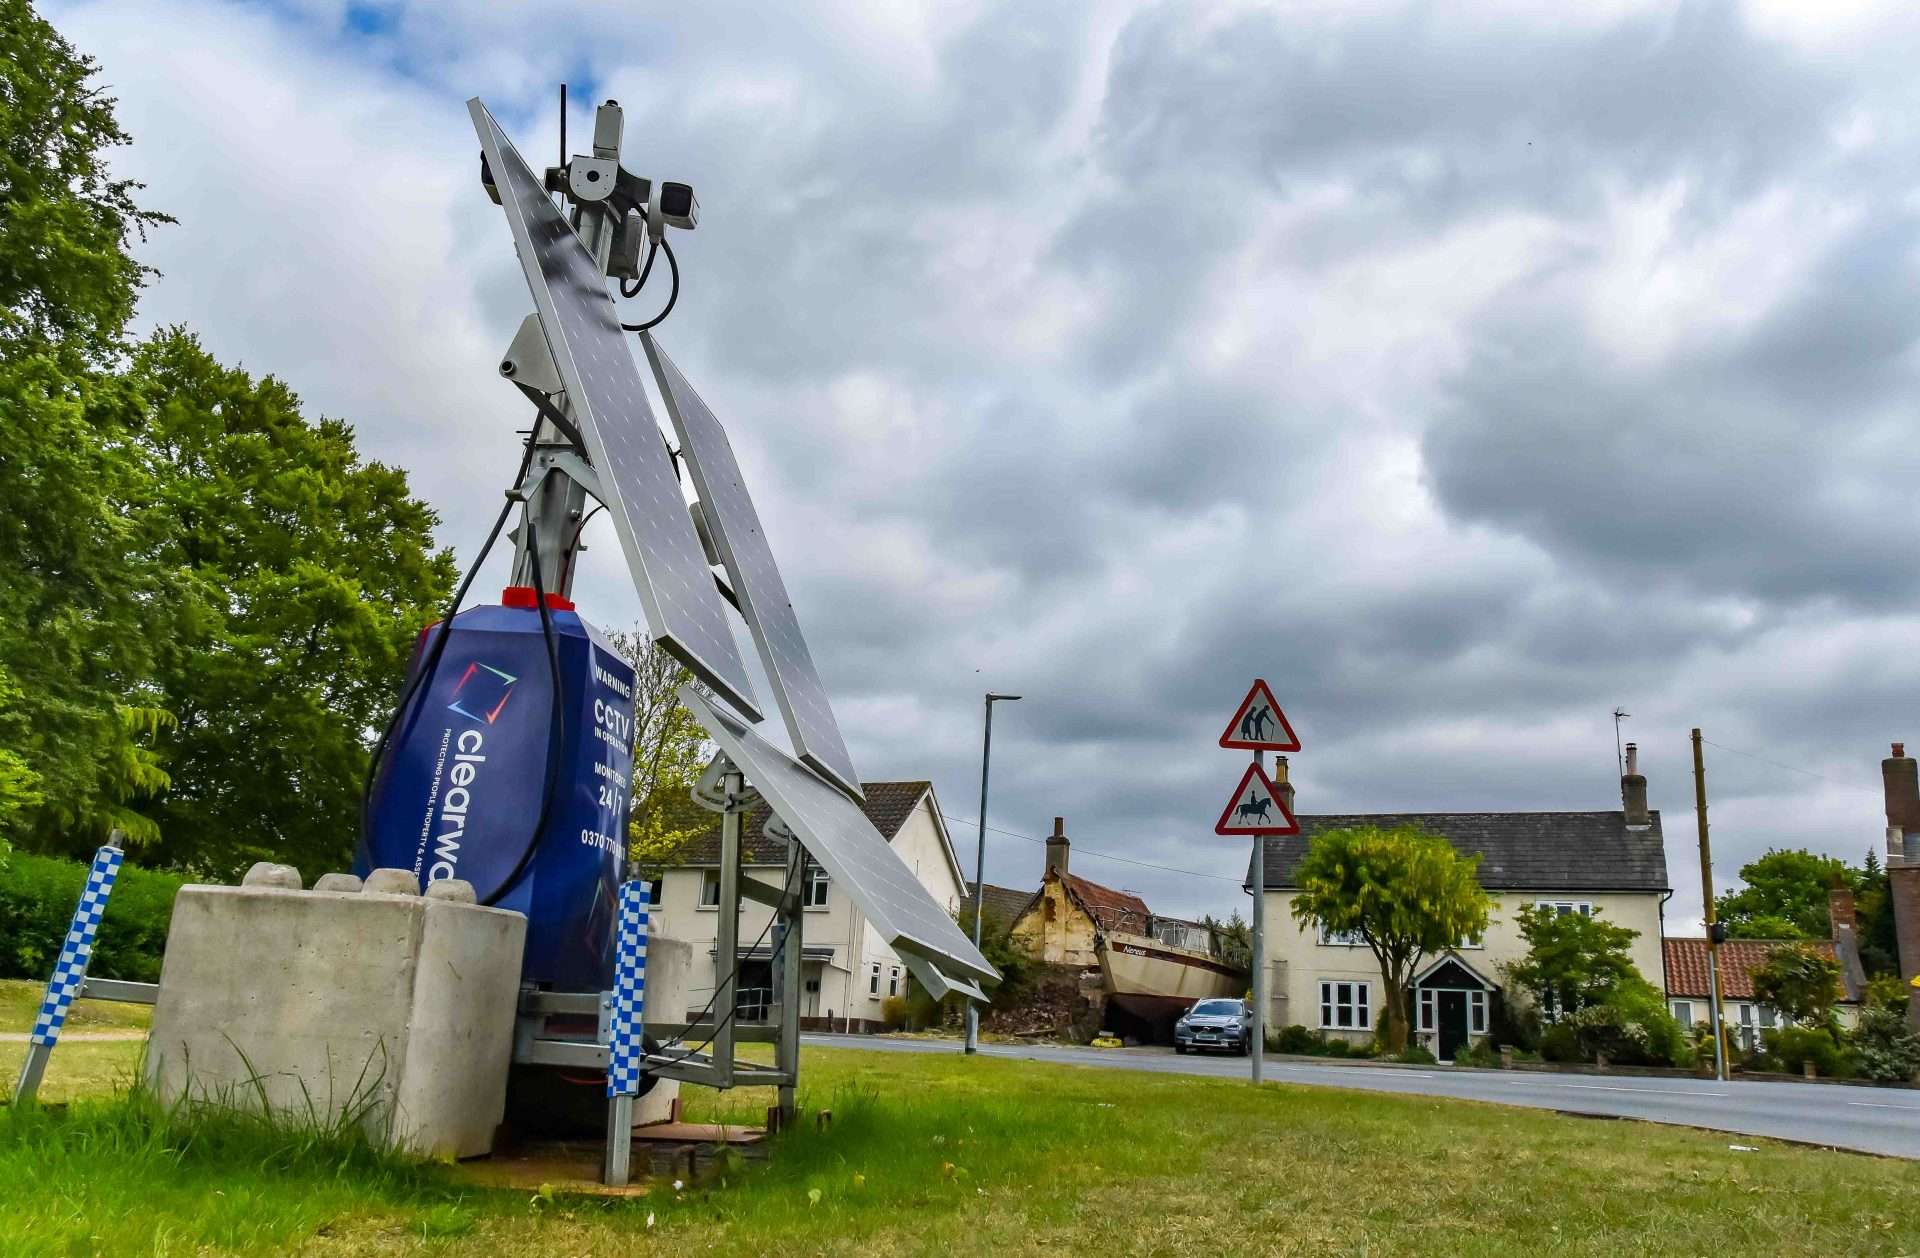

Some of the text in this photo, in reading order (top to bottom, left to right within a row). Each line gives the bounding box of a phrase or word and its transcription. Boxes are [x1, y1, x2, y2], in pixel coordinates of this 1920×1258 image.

[595, 664, 631, 699] WARNING
[594, 726, 602, 739] IN
[595, 698, 630, 740] CCTV
[435, 728, 452, 776] PROTECTING
[594, 761, 627, 790] MONITORED
[599, 785, 623, 816] 24/7
[419, 807, 434, 847] PROPERTY
[581, 829, 604, 849] 0370
